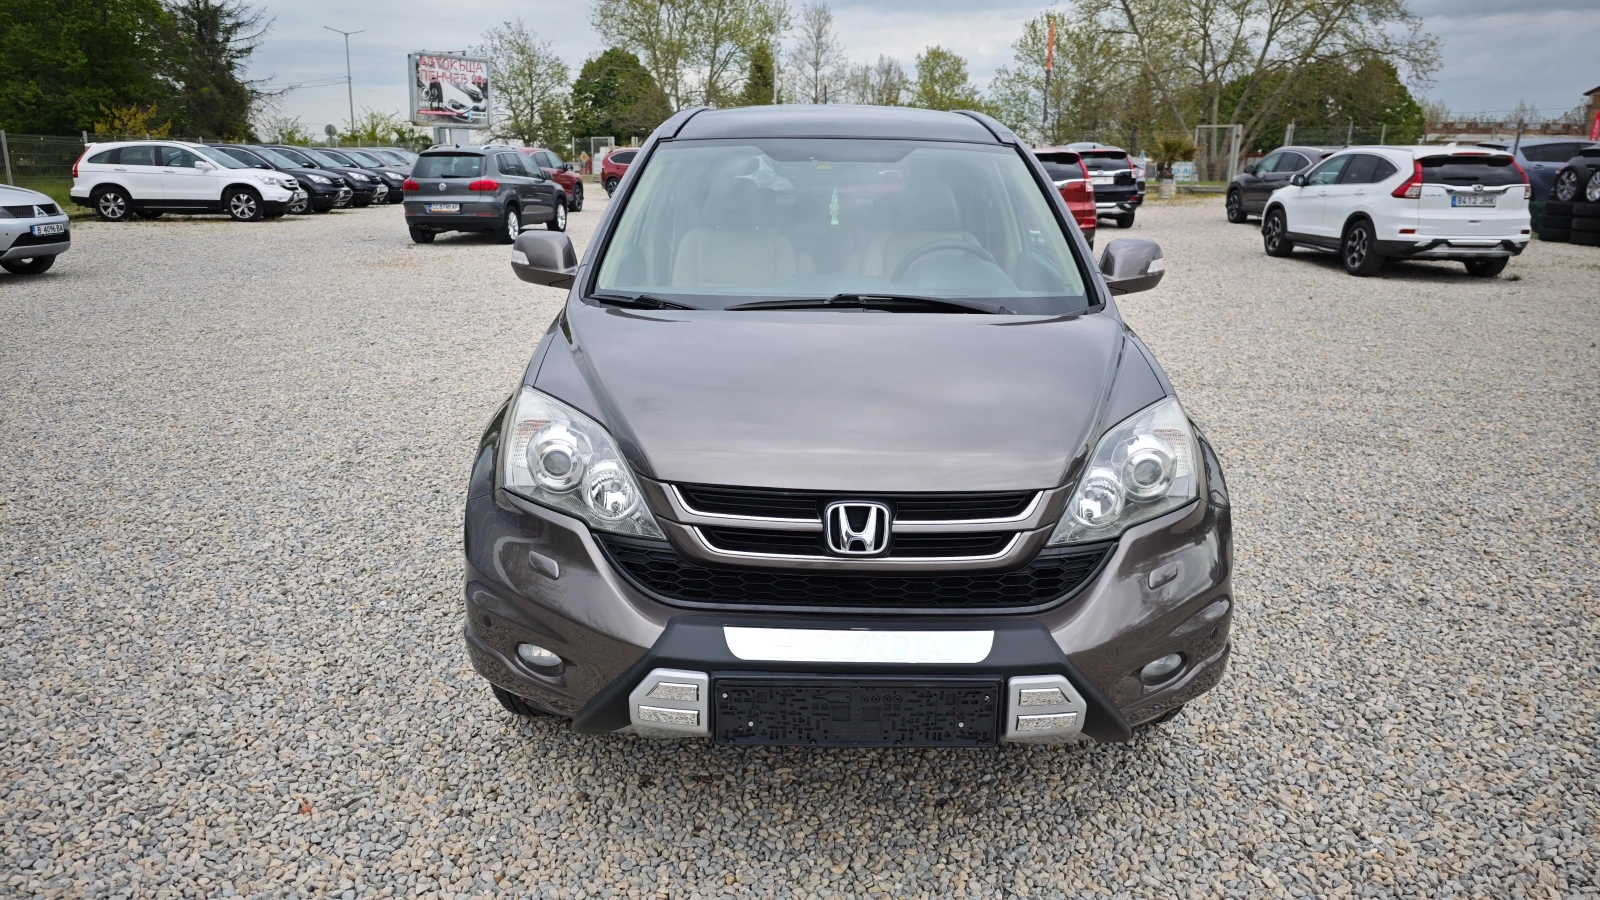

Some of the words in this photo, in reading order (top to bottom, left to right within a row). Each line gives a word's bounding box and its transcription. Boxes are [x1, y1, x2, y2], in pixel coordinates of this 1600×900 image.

[419, 55, 483, 73] АВТОКЪЩА
[420, 70, 468, 85] ПЕНЧЕВ
[1457, 197, 1477, 205] 8412
[1480, 197, 1494, 205] JHK
[44, 225, 56, 233] 4096
